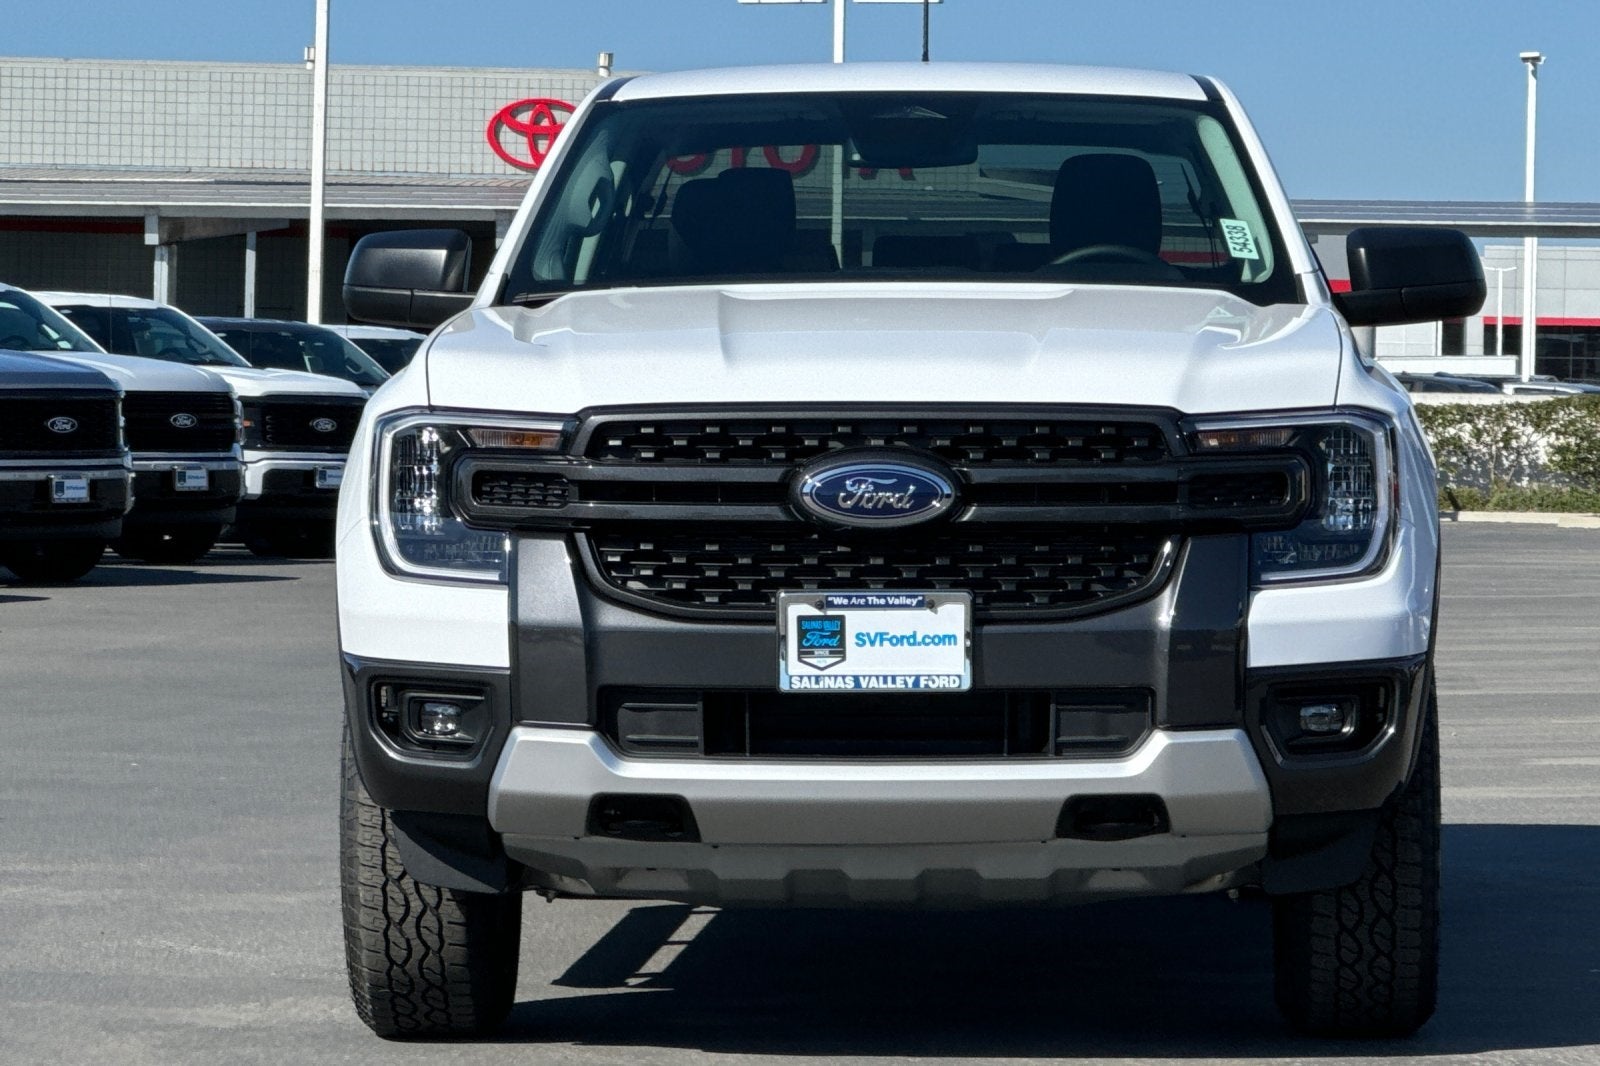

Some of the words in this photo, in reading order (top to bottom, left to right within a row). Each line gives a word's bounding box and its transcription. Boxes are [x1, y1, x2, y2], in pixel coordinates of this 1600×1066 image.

[1225, 225, 1253, 253] 54338
[53, 419, 73, 431] Ford
[837, 476, 917, 509] Ford
[850, 597, 865, 605] Are
[867, 596, 886, 605] The
[802, 631, 840, 646] Ford
[855, 631, 958, 648] SVFord.com
[791, 675, 855, 689] SALINAS
[859, 676, 915, 689] VALLEY
[919, 676, 960, 689] FORD
